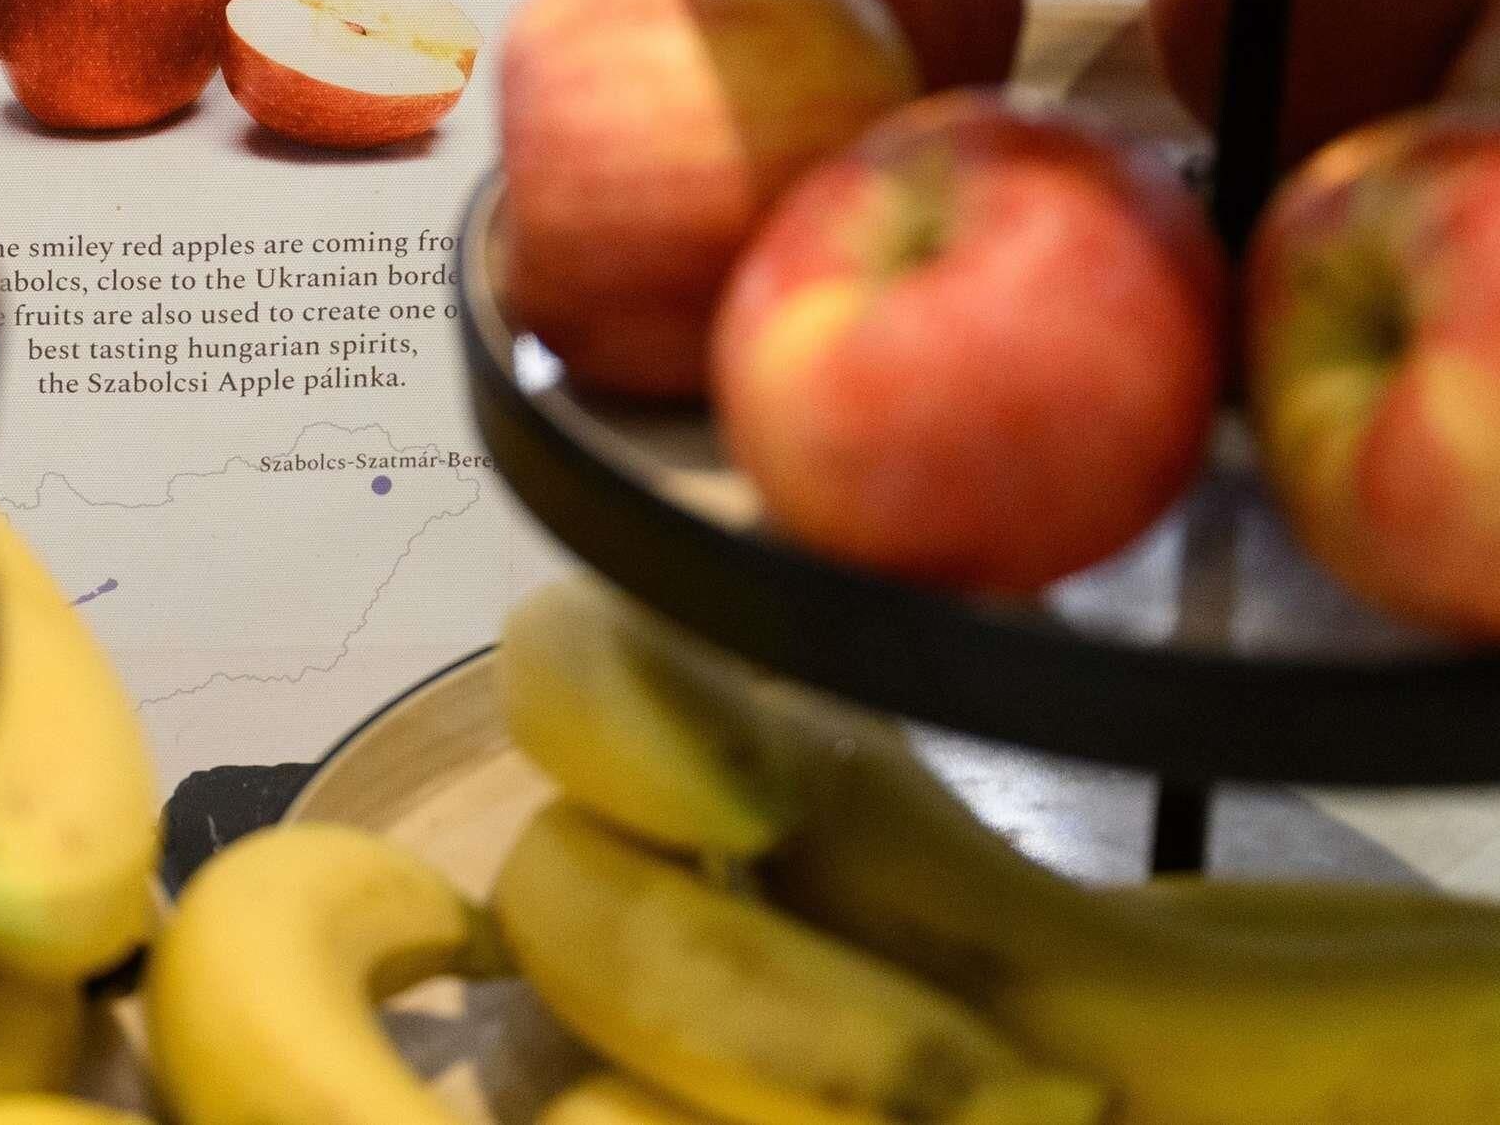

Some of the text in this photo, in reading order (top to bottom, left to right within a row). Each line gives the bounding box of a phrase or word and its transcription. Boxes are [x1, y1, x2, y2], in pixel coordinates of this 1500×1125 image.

[27, 233, 114, 265] smiley
[121, 233, 162, 258] red
[171, 232, 256, 264] apples
[263, 238, 305, 256] are
[311, 230, 409, 259] coming
[96, 266, 163, 292] close
[170, 271, 197, 291] to
[204, 265, 247, 291] the
[255, 263, 379, 290] Ukranian
[13, 302, 85, 327] fruits
[92, 308, 134, 326] are
[140, 301, 193, 326] also
[200, 299, 260, 325] used
[268, 304, 295, 324] to
[301, 303, 382, 323] create
[388, 303, 436, 321] one
[27, 331, 420, 366] best tasting hungarian spirits,
[37, 364, 407, 400] the Szabolcsi Apple pálinka.
